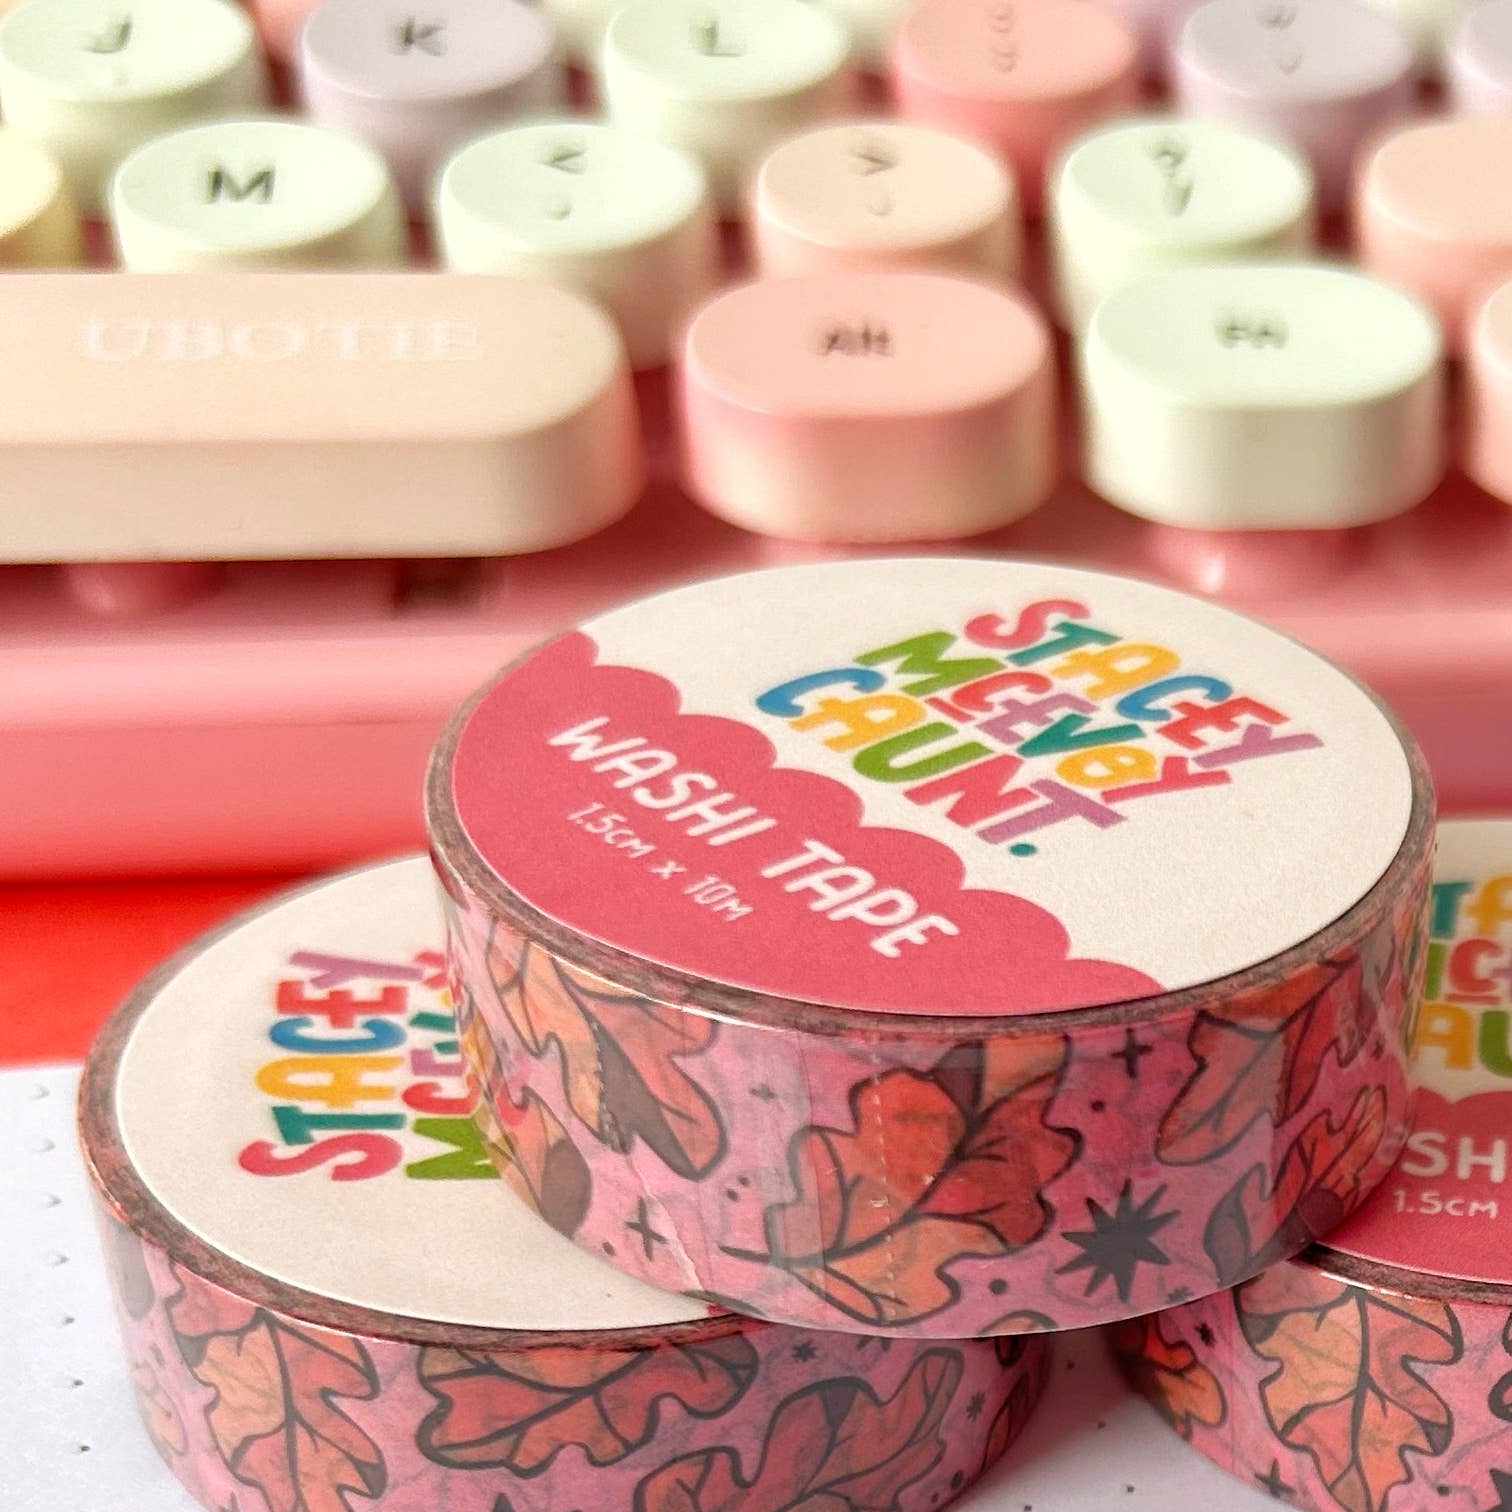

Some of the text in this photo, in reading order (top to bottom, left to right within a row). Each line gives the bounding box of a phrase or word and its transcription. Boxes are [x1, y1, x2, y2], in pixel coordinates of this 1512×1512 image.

[393, 16, 448, 57] K
[693, 20, 746, 57] L
[205, 165, 276, 204] M
[755, 667, 1128, 857] CAUNT.
[964, 598, 1324, 768] STACEY
[547, 716, 960, 958] WASHI TAPE
[238, 951, 424, 1182] STACEY
